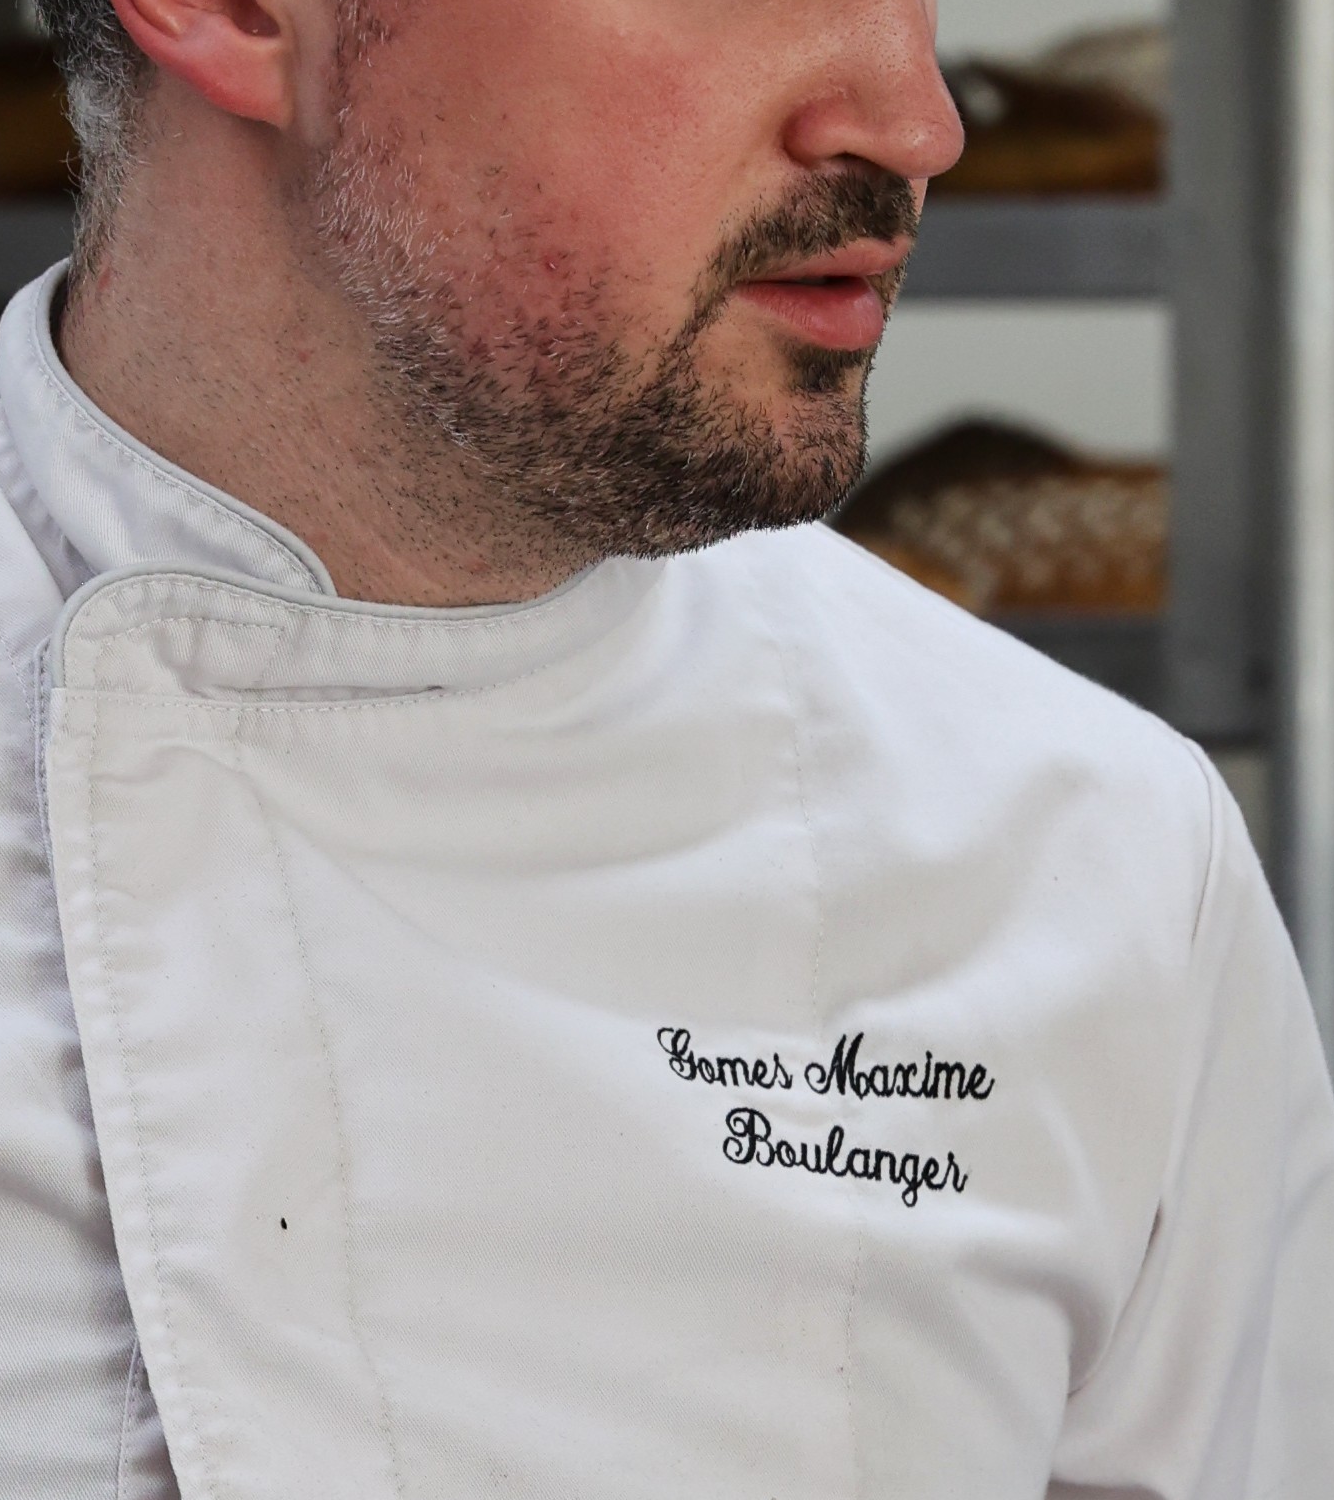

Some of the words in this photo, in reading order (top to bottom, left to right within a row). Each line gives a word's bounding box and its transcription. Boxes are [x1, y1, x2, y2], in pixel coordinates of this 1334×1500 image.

[657, 1027, 793, 1090] Gomes
[804, 1032, 996, 1100] Maxime
[722, 1107, 969, 1208] Boulanger
